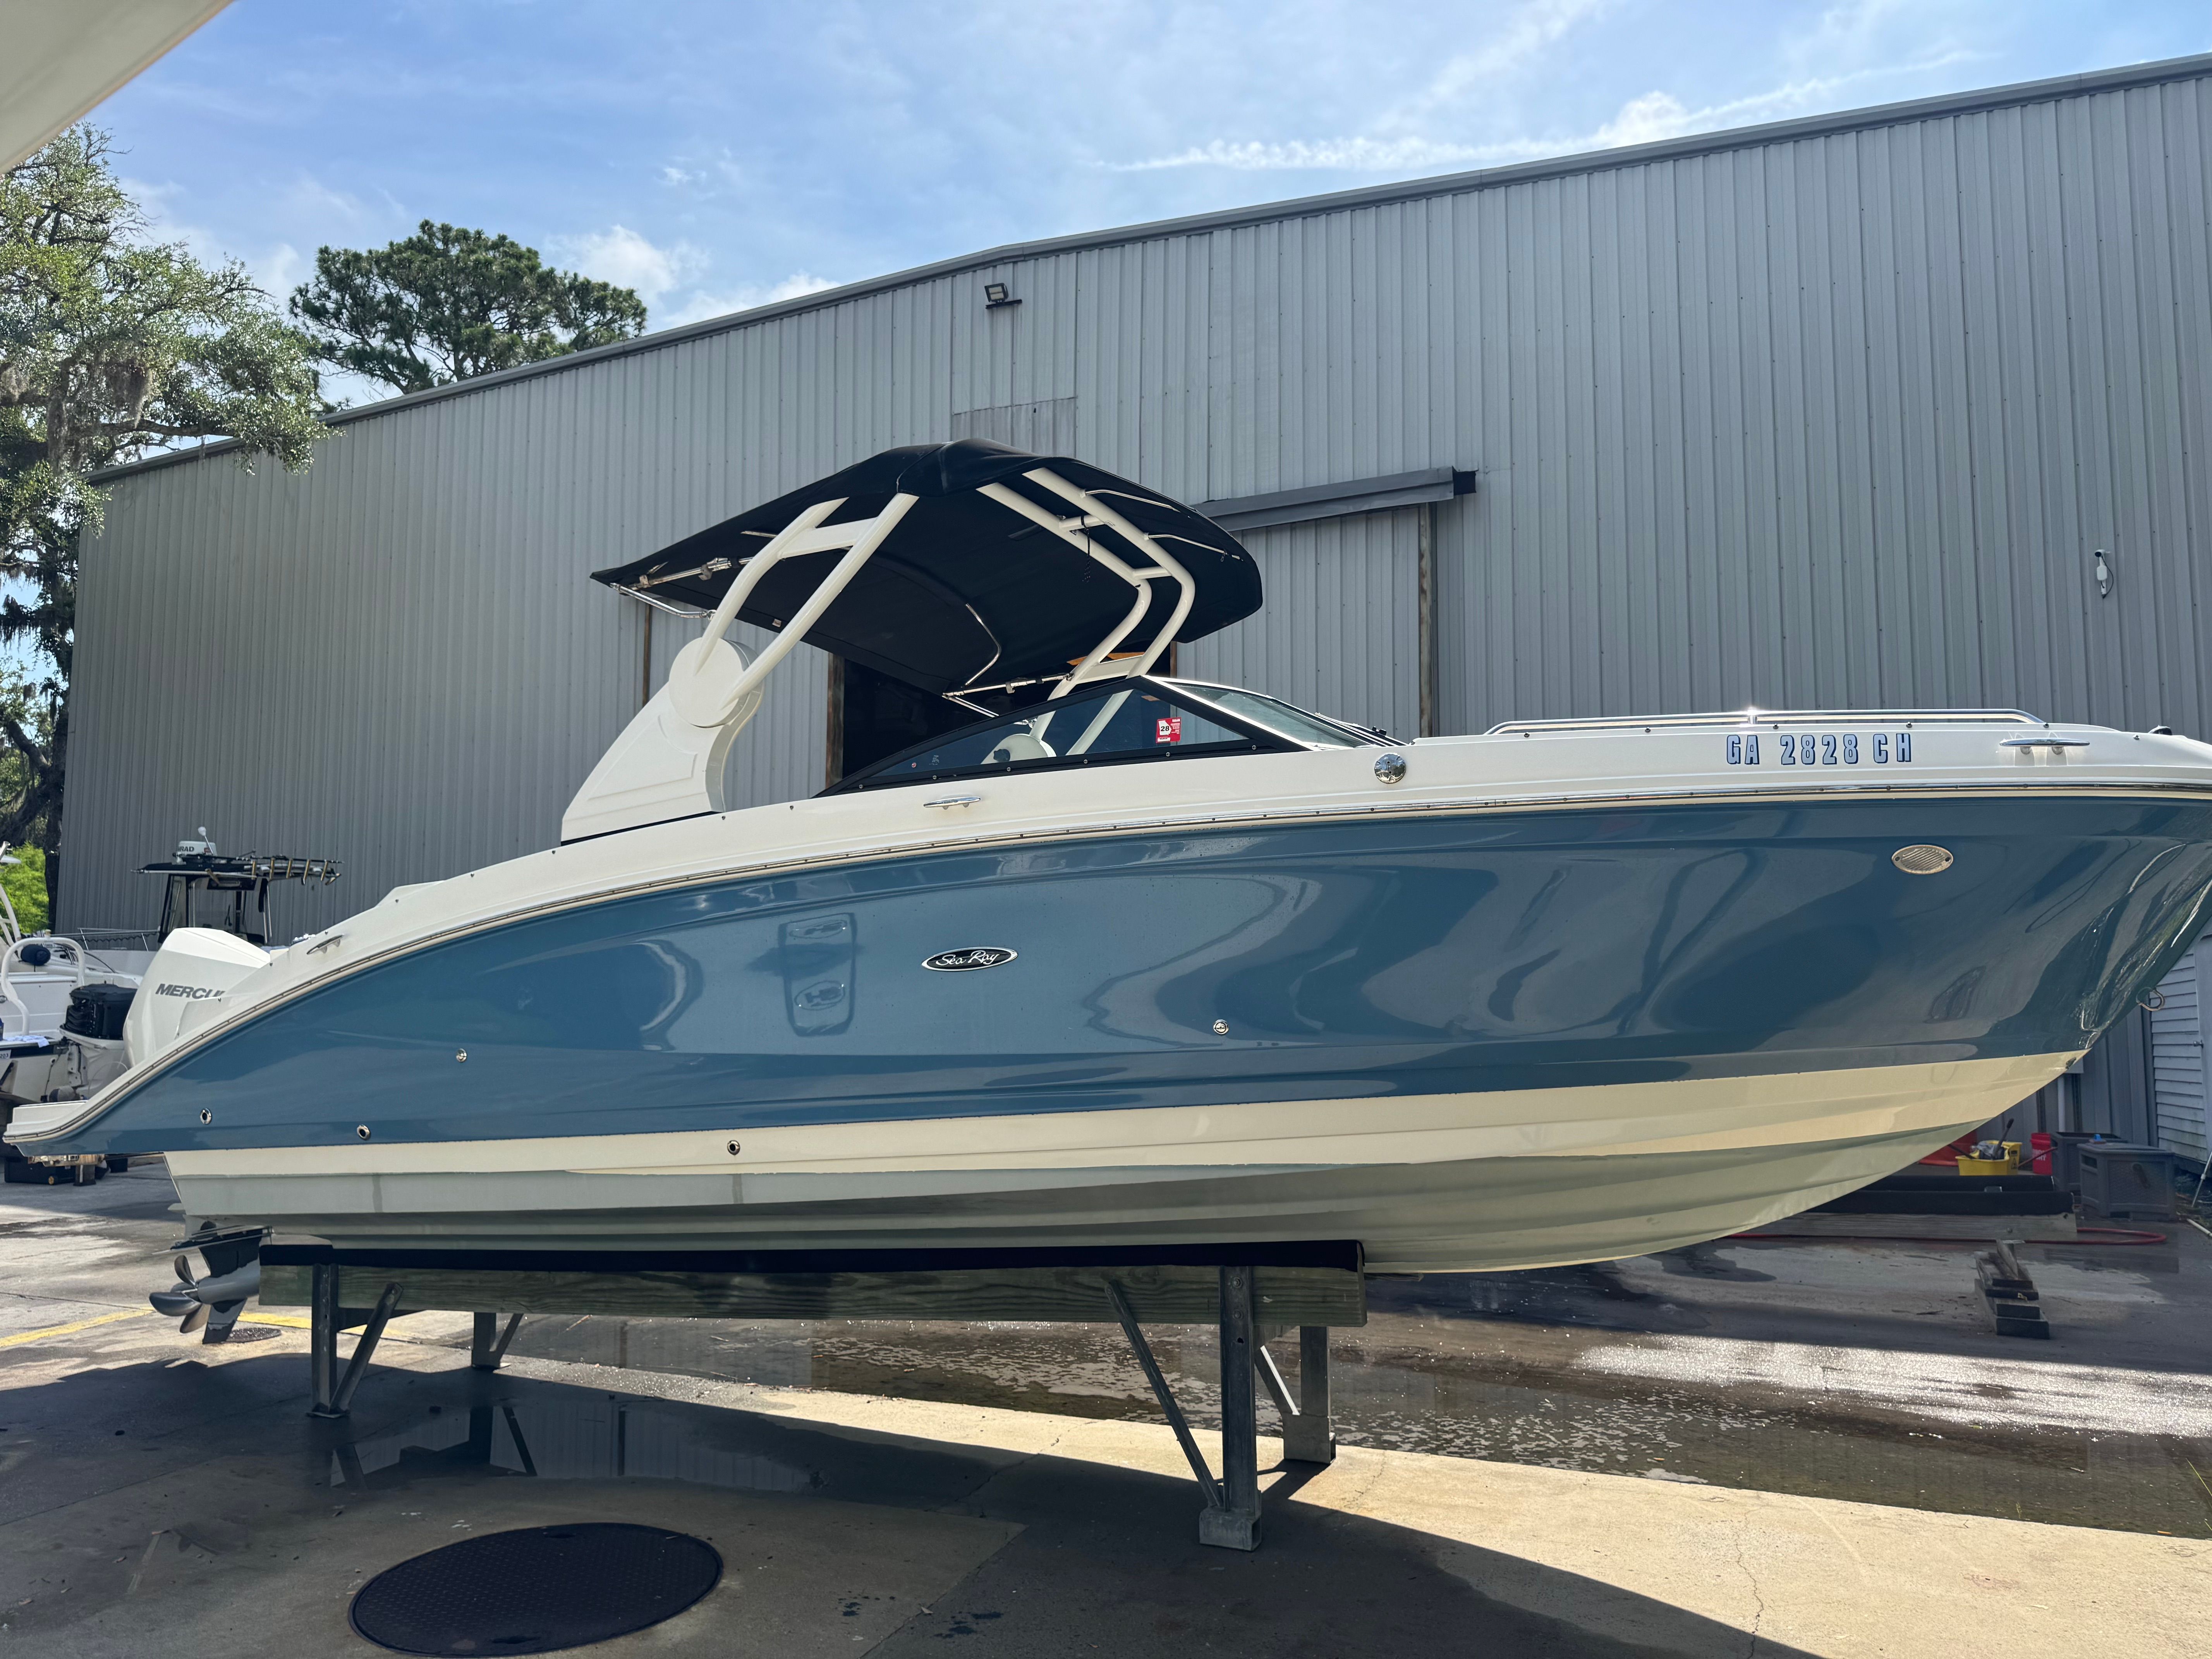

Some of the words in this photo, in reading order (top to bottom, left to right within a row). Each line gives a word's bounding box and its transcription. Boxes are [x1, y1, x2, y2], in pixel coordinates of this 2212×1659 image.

[1726, 735, 1759, 764] GA
[1780, 734, 1858, 765] 2828
[1873, 733, 1911, 764] CH
[936, 954, 967, 966] Sea
[968, 950, 1000, 965] Ray
[155, 983, 225, 999] MERCU
